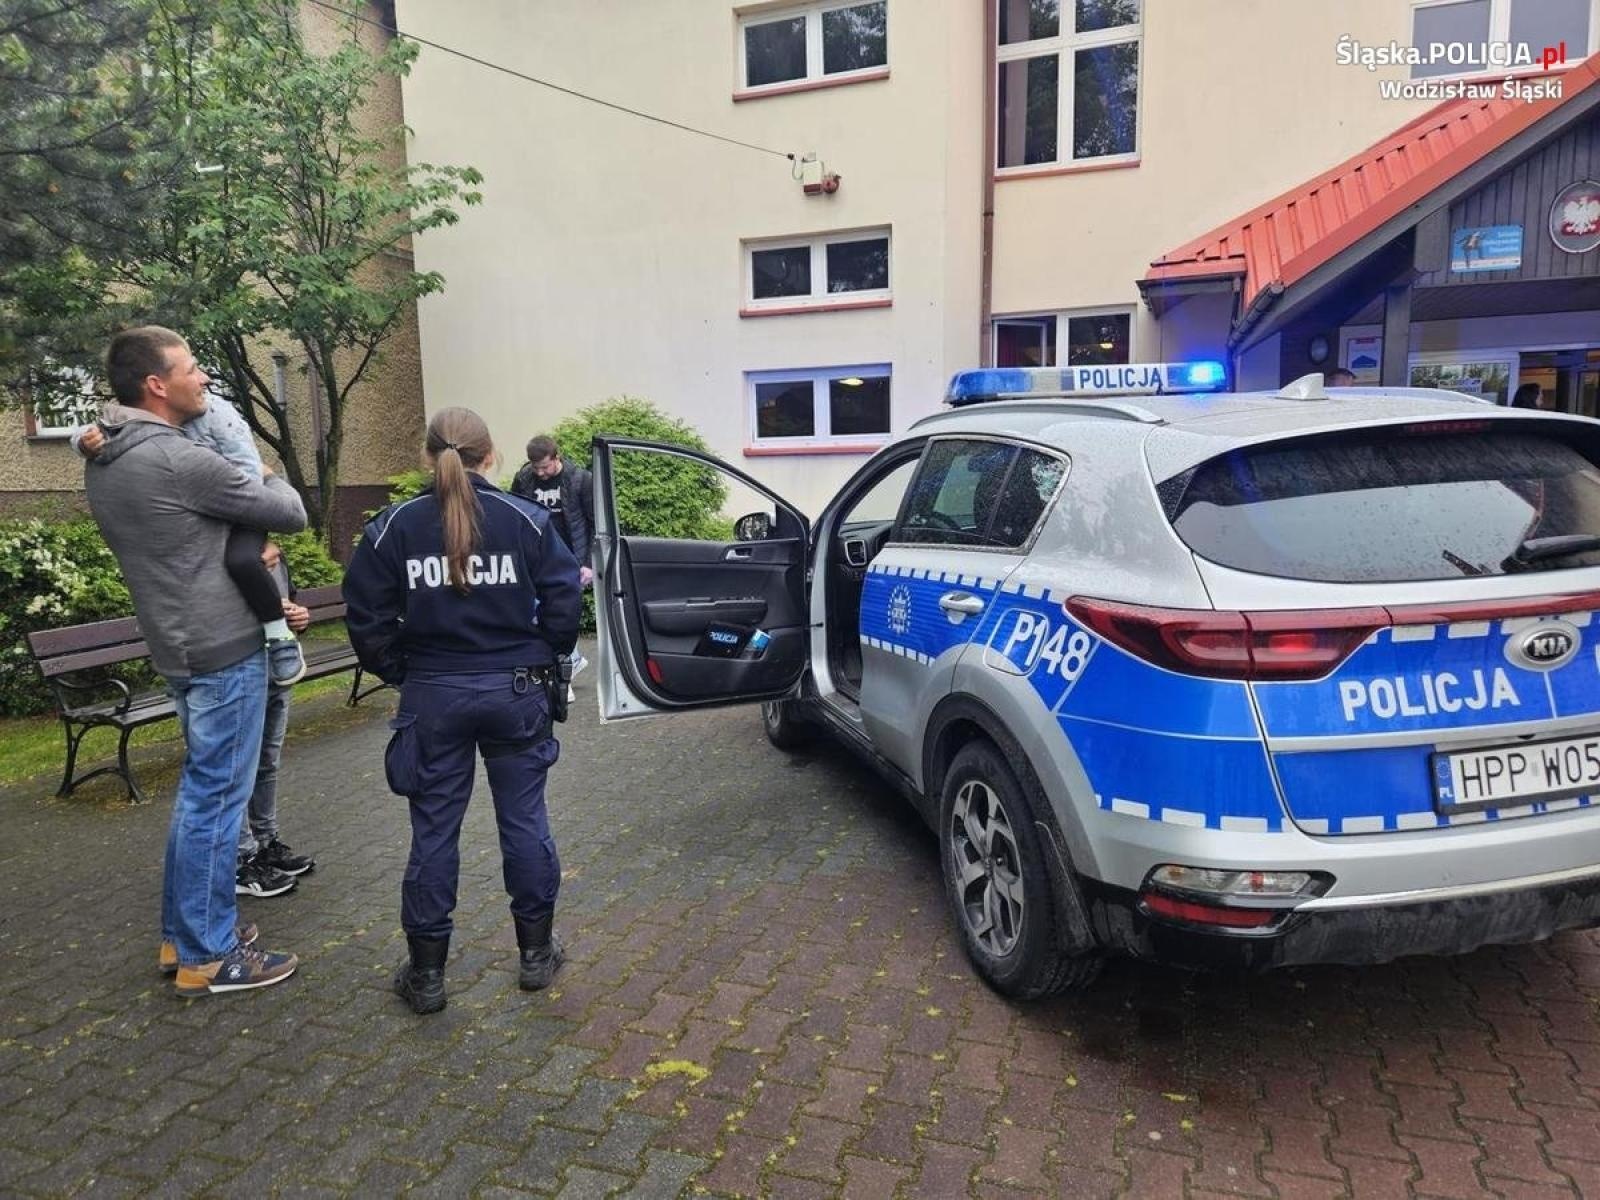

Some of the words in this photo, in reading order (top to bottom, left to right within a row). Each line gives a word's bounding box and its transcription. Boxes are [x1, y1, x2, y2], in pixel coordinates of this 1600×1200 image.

[1079, 367, 1164, 389] POLICJA
[406, 554, 518, 590] POLCJA
[1002, 611, 1091, 681] P148
[1533, 635, 1570, 657] KIA
[1339, 667, 1521, 721] POLICJA
[1439, 787, 1454, 799] PL
[1460, 752, 1527, 799] HPP
